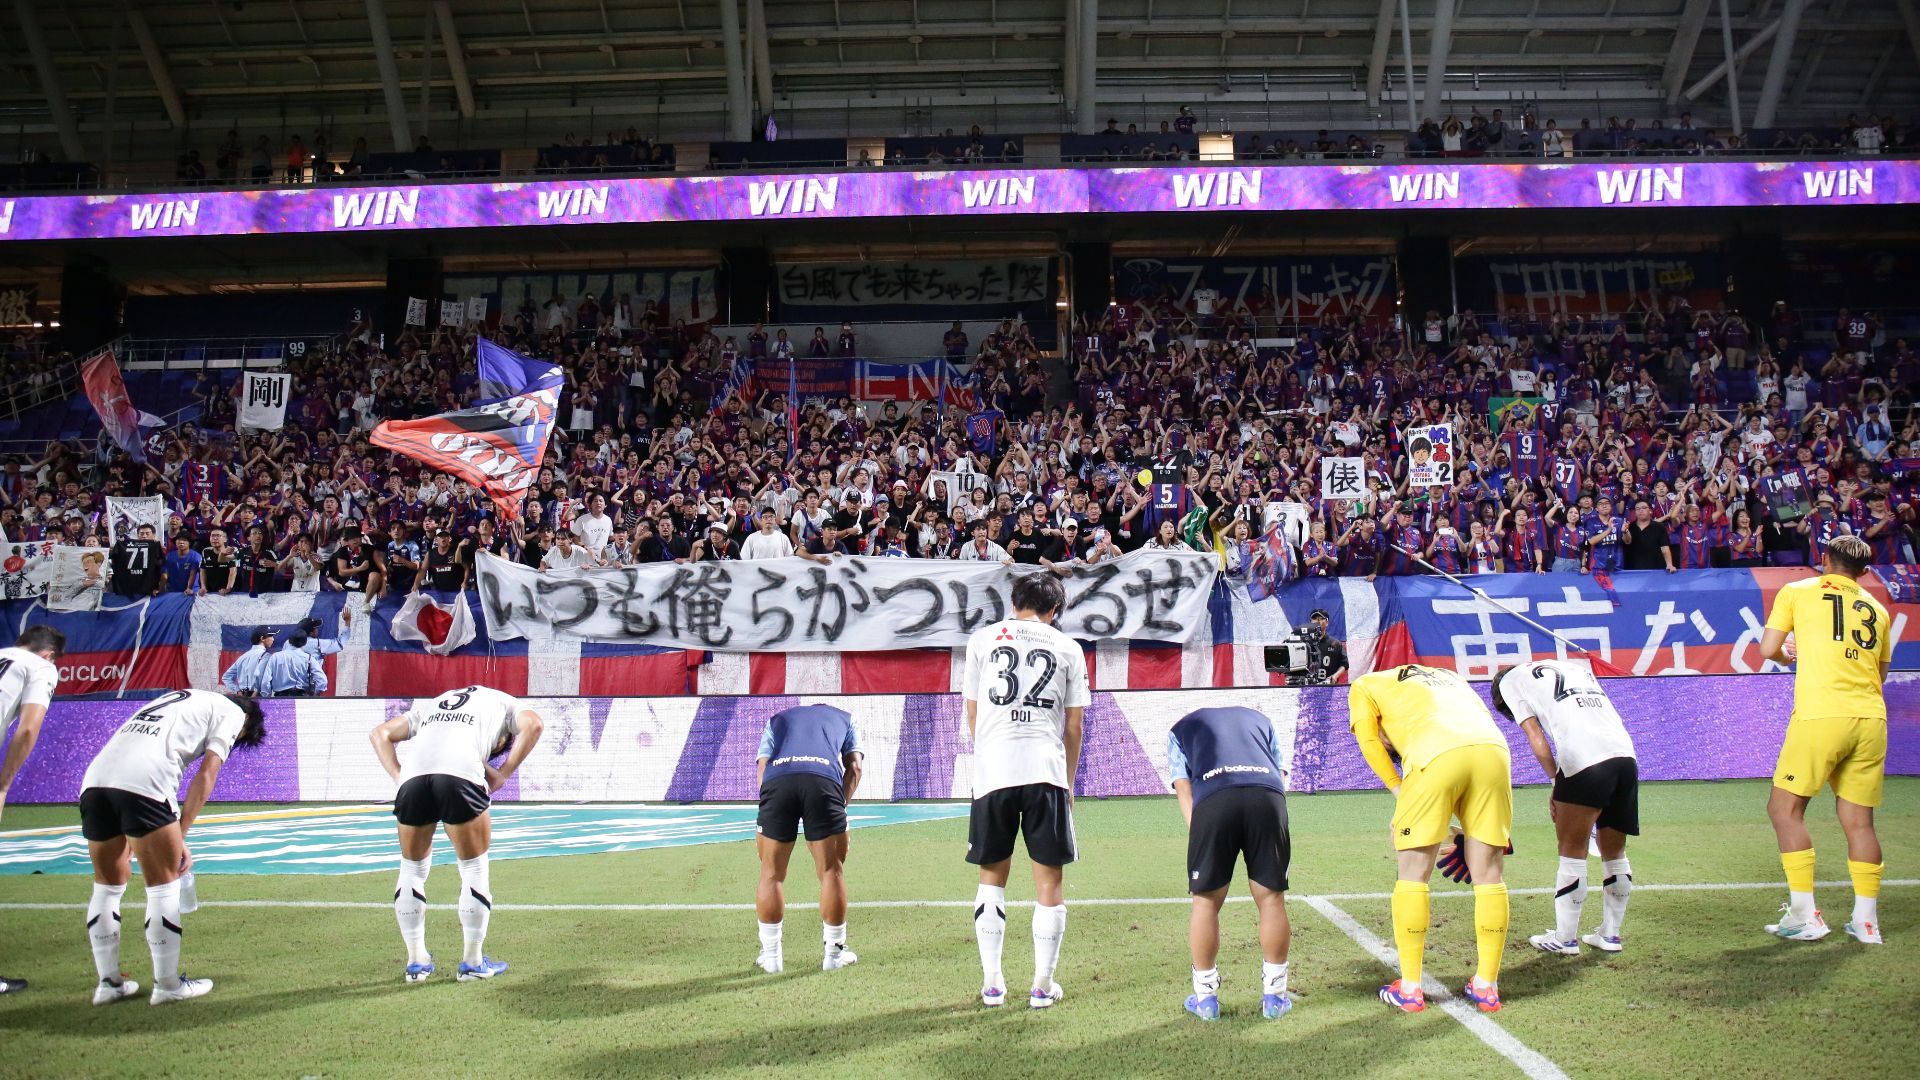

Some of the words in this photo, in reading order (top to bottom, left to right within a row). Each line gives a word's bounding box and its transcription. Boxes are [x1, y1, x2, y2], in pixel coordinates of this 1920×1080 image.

[962, 175, 1035, 208] WIN
[1172, 169, 1263, 208] WIN
[1388, 170, 1460, 202] WIN
[1596, 166, 1684, 204] WIN
[1803, 167, 1874, 198] WIN
[538, 186, 609, 219] WIN
[748, 176, 839, 216] WIN
[132, 199, 200, 230] WIN
[333, 188, 420, 228] WIN
[1849, 321, 1867, 335] 39
[288, 341, 306, 355] 99
[249, 375, 285, 408] 剛
[1542, 403, 1560, 419] 37
[974, 418, 992, 438] 10
[1521, 435, 1533, 454] 9
[199, 464, 208, 482] 3
[956, 473, 975, 493] 10
[1325, 461, 1361, 495] 俵
[1555, 462, 1575, 484] 37
[1160, 484, 1173, 503] 5
[24, 541, 54, 559] 東京
[126, 547, 149, 569] 71
[1822, 593, 1878, 650] 13
[1845, 648, 1859, 660] GO
[988, 645, 1058, 710] 32
[133, 689, 192, 722] 2
[438, 685, 478, 711] 3
[1575, 697, 1603, 708] ENDO
[1011, 709, 1032, 723] DOI
[772, 755, 792, 767] new
[792, 755, 830, 766] balance
[1202, 765, 1223, 781] new
[1224, 764, 1270, 775] balance
